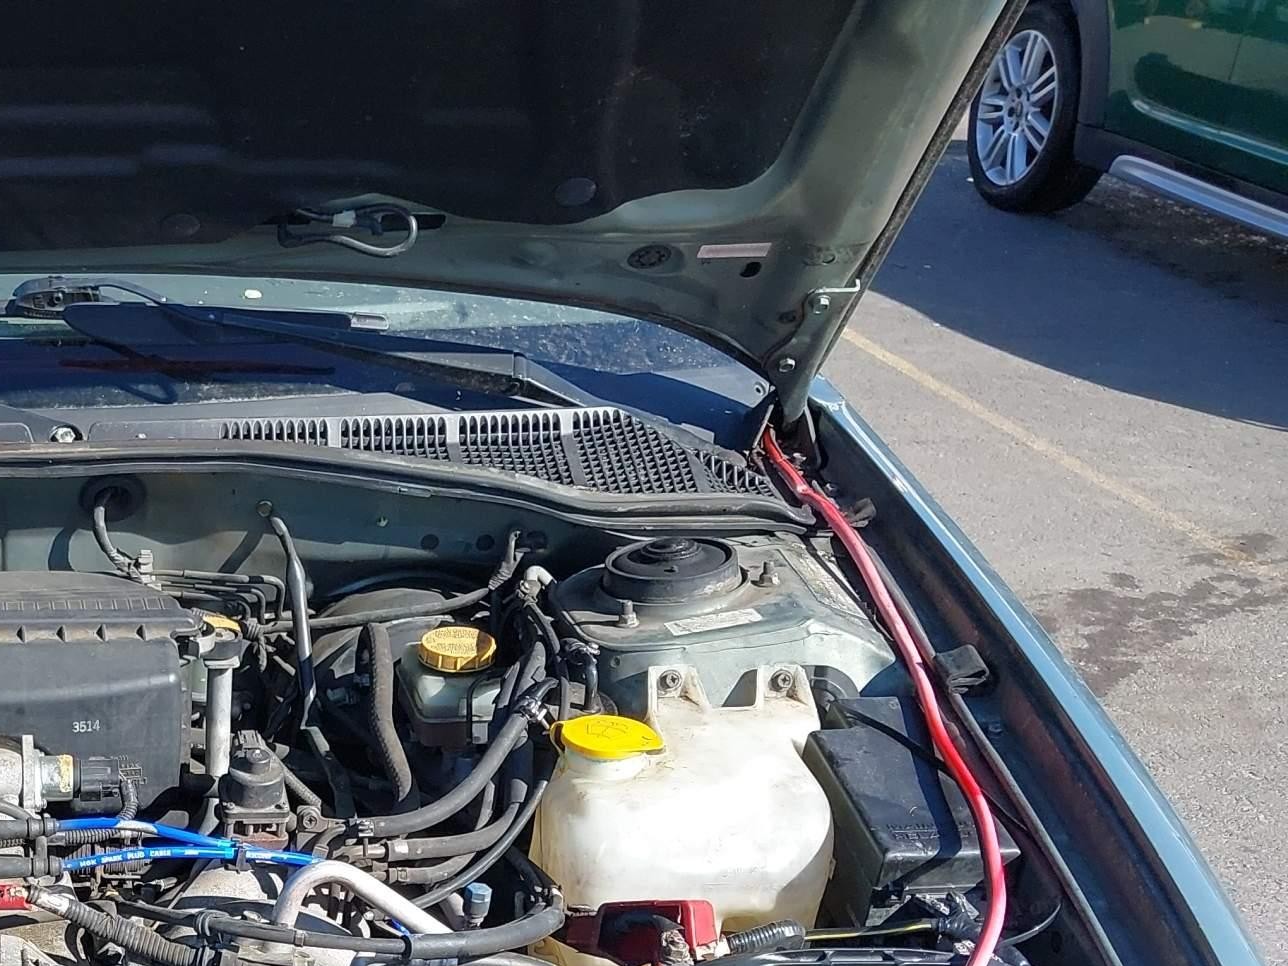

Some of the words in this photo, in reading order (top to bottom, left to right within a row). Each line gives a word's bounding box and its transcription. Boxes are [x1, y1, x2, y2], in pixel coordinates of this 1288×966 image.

[72, 719, 101, 733] 3514
[101, 854, 123, 863] SPARK
[127, 850, 145, 859] PLUG
